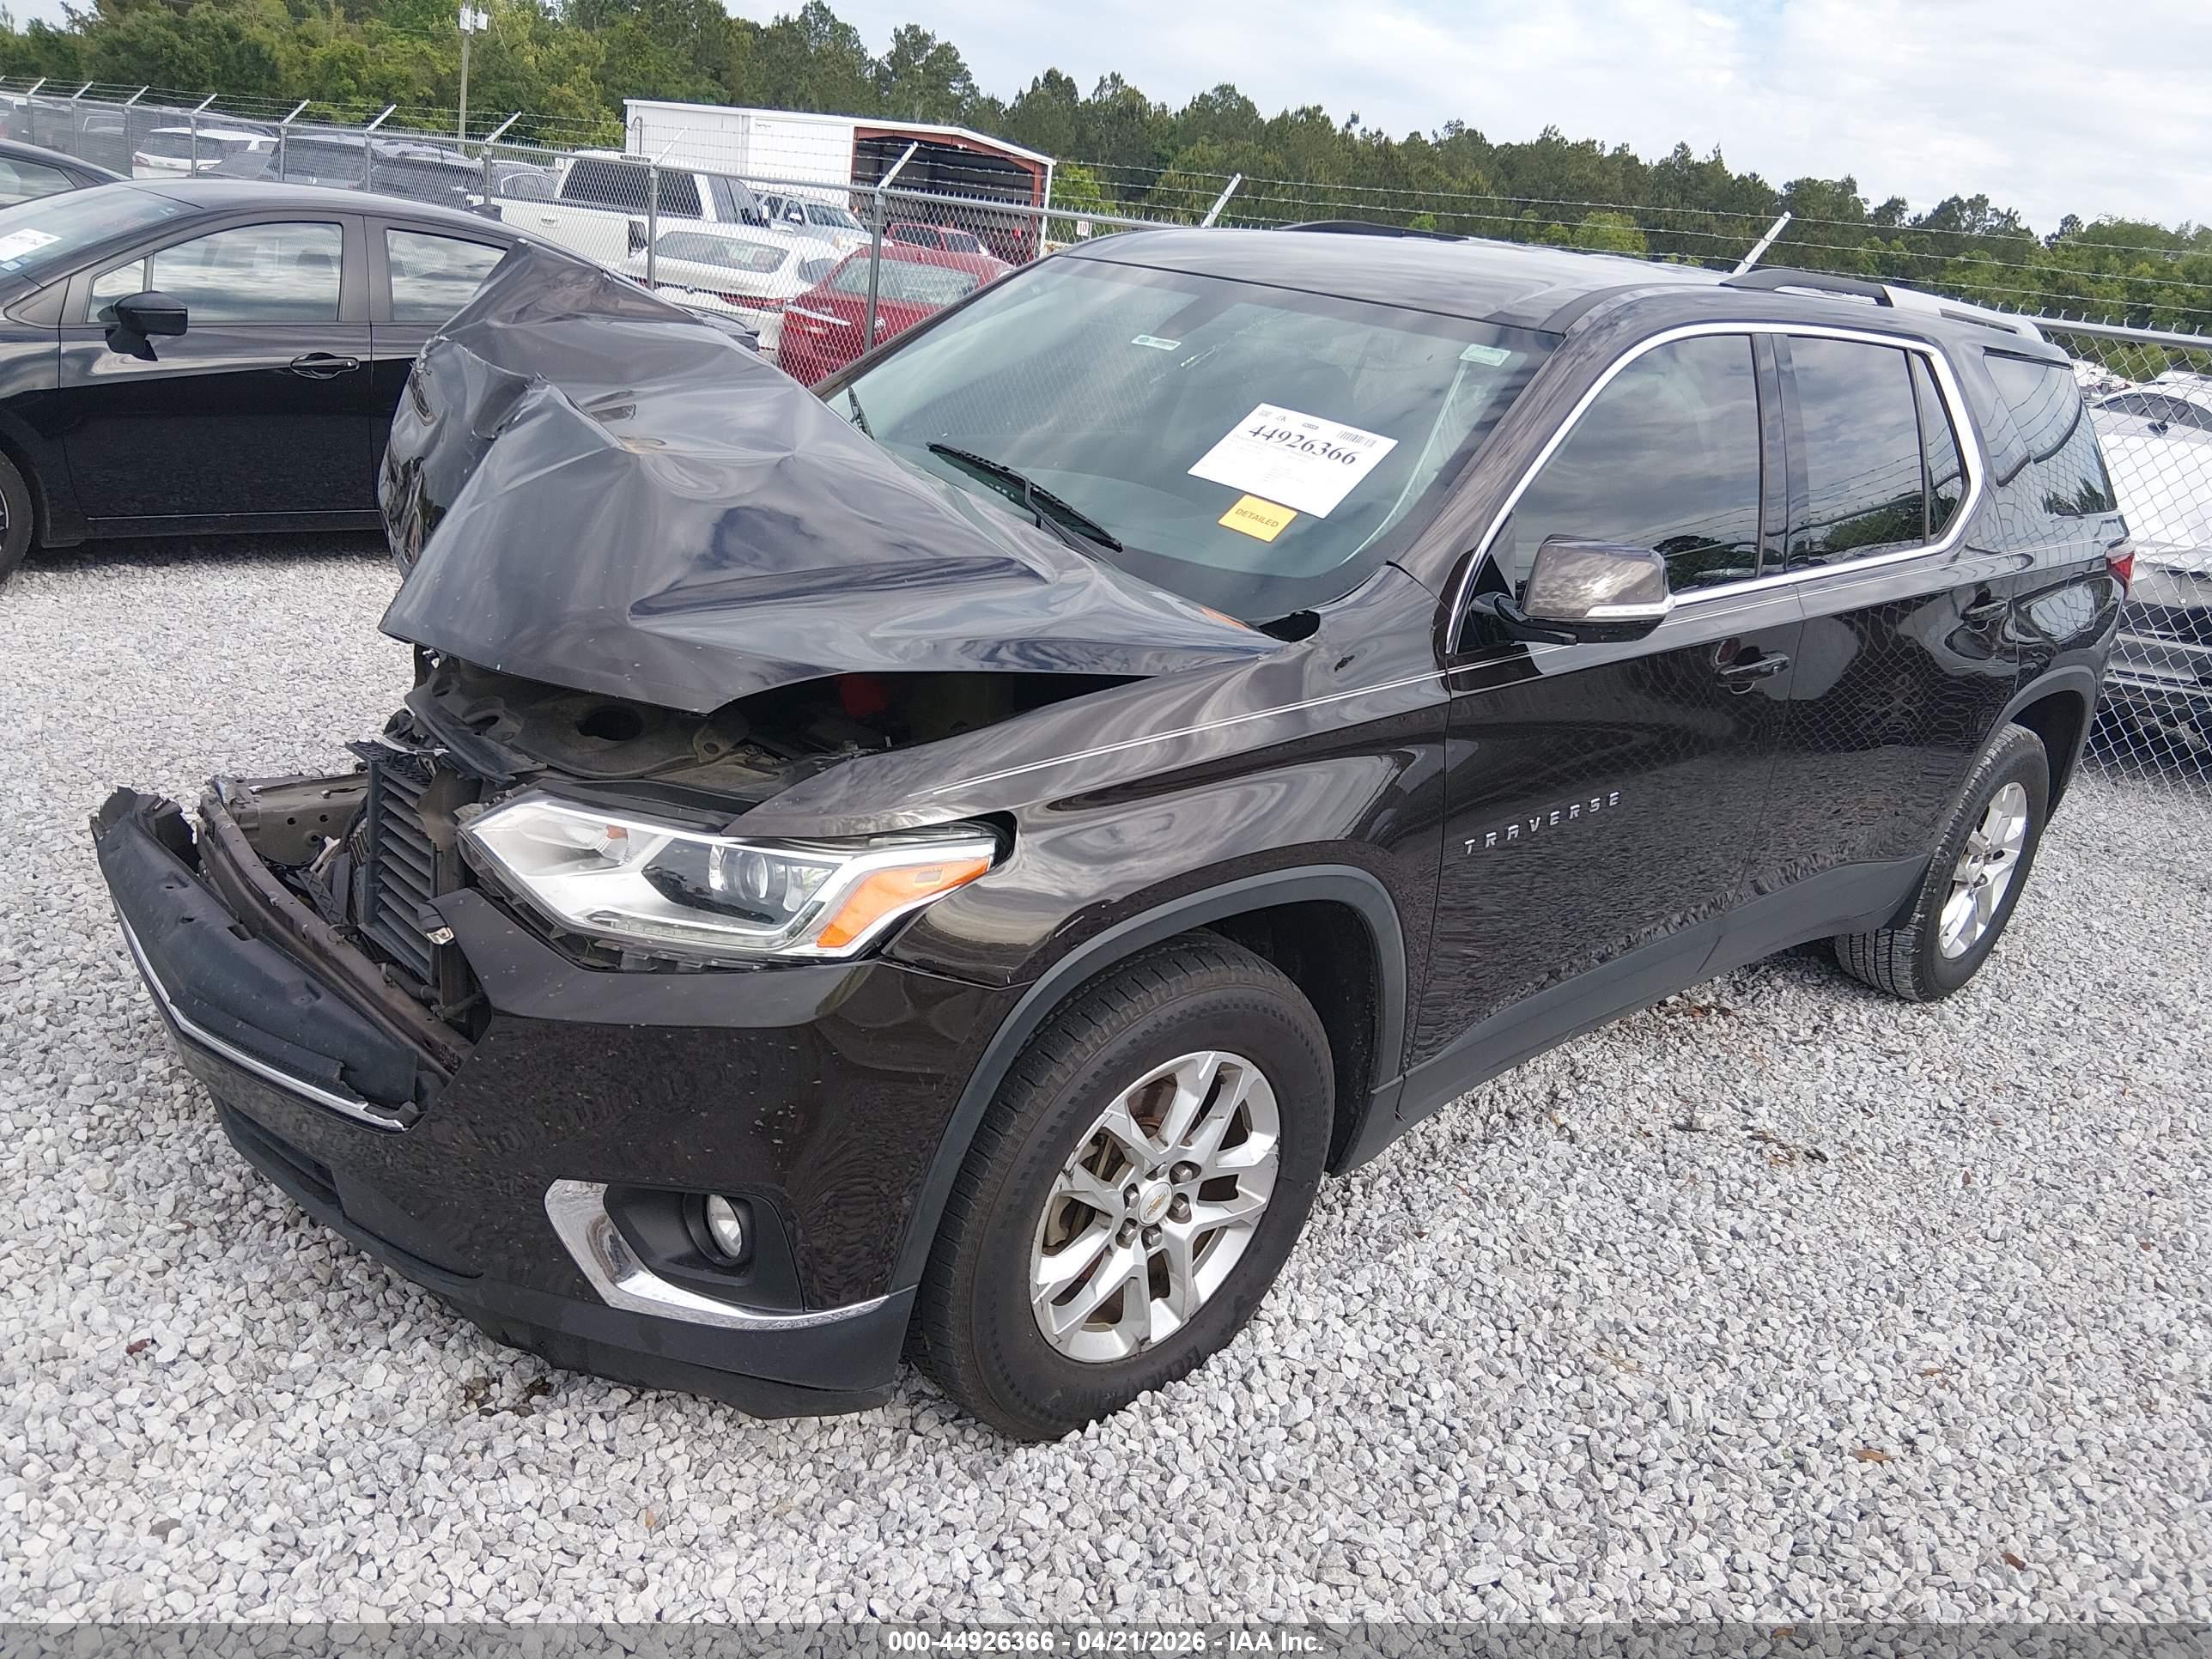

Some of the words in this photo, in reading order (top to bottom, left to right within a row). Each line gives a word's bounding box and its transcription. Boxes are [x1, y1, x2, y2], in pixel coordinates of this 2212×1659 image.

[1248, 424, 1363, 466] 44926366
[1234, 507, 1279, 528] DETAILED
[1464, 791, 1621, 855] TRAVERSE
